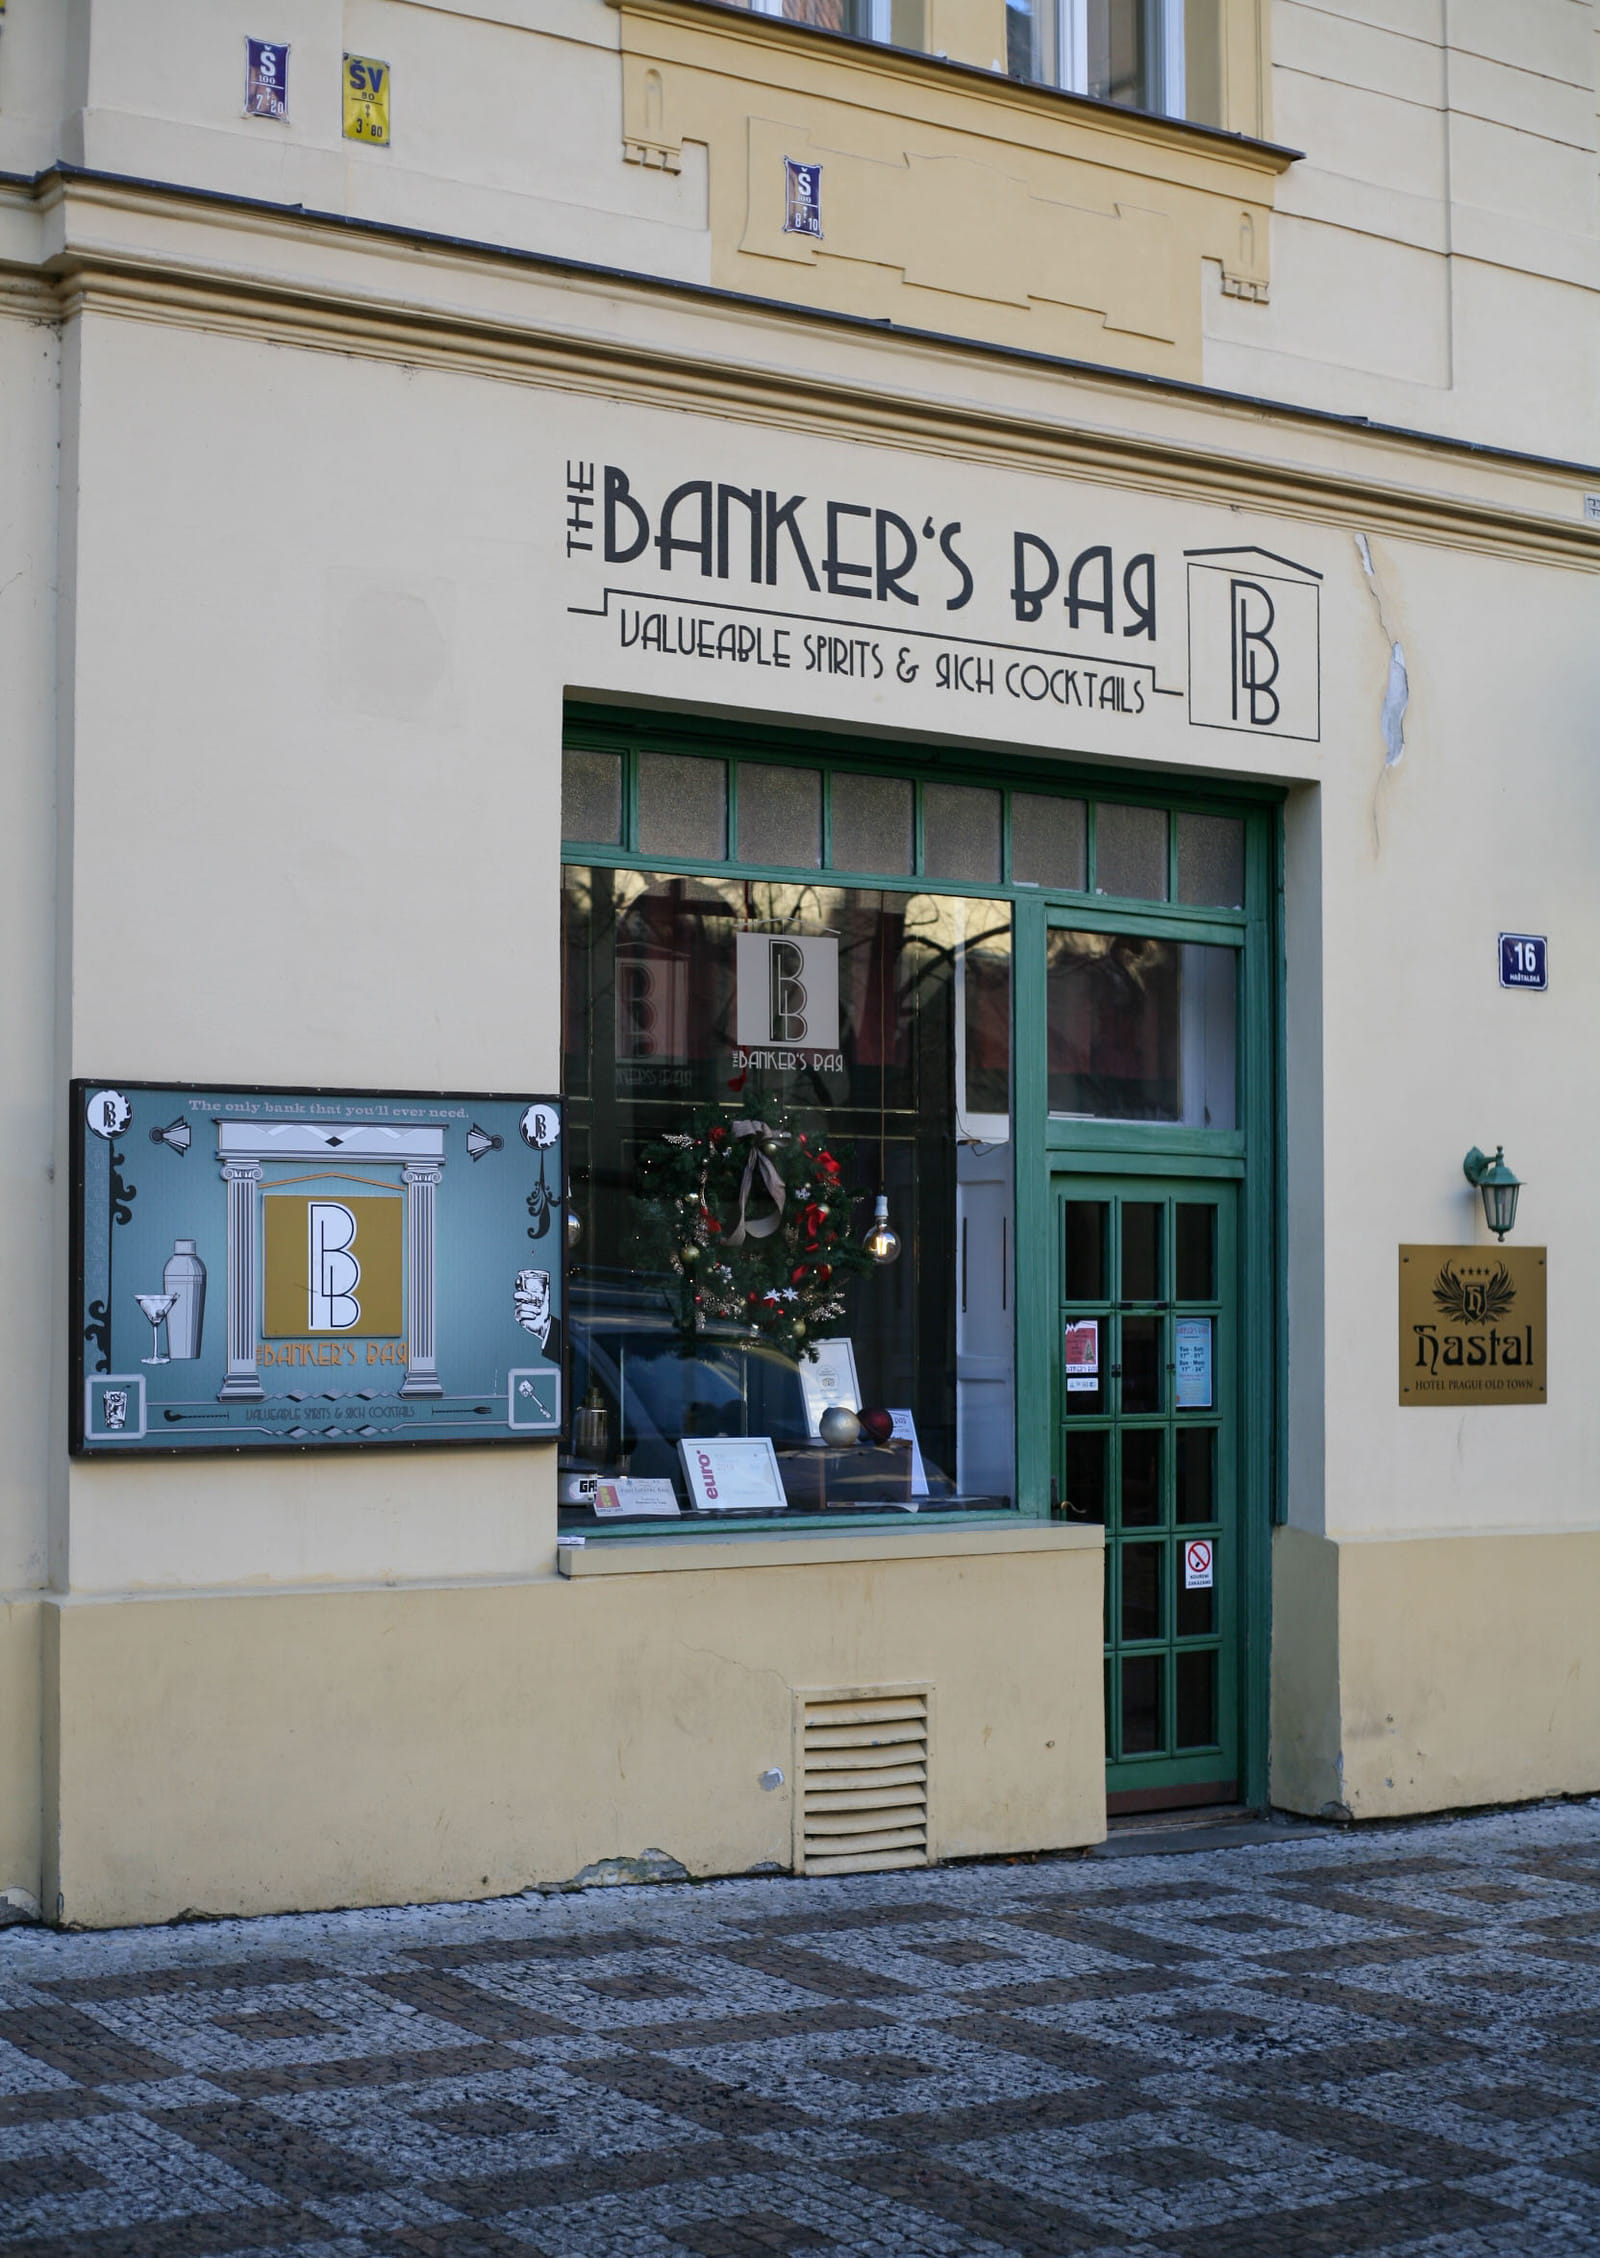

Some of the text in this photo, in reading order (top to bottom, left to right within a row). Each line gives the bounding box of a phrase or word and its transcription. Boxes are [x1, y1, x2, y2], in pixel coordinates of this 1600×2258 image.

[260, 44, 277, 77] Š
[258, 74, 277, 85] 100
[349, 60, 384, 93] ŠV
[361, 91, 375, 101] 80
[798, 166, 812, 196] Š
[566, 459, 595, 558] THE
[603, 464, 974, 611] BANKER'S
[620, 609, 792, 670] VALUEABLE
[803, 635, 885, 681] SPIRITS
[895, 646, 920, 684] &
[1004, 662, 1146, 715] COCKTAILS
[1513, 942, 1537, 972] 16
[739, 1050, 807, 1071] BANKER'S
[189, 1099, 470, 1119] The only bank that you'll ever need.
[264, 1343, 358, 1367] BANKER'S
[1415, 1379, 1534, 1391] HOTEL PRAGUE OLD TOWN
